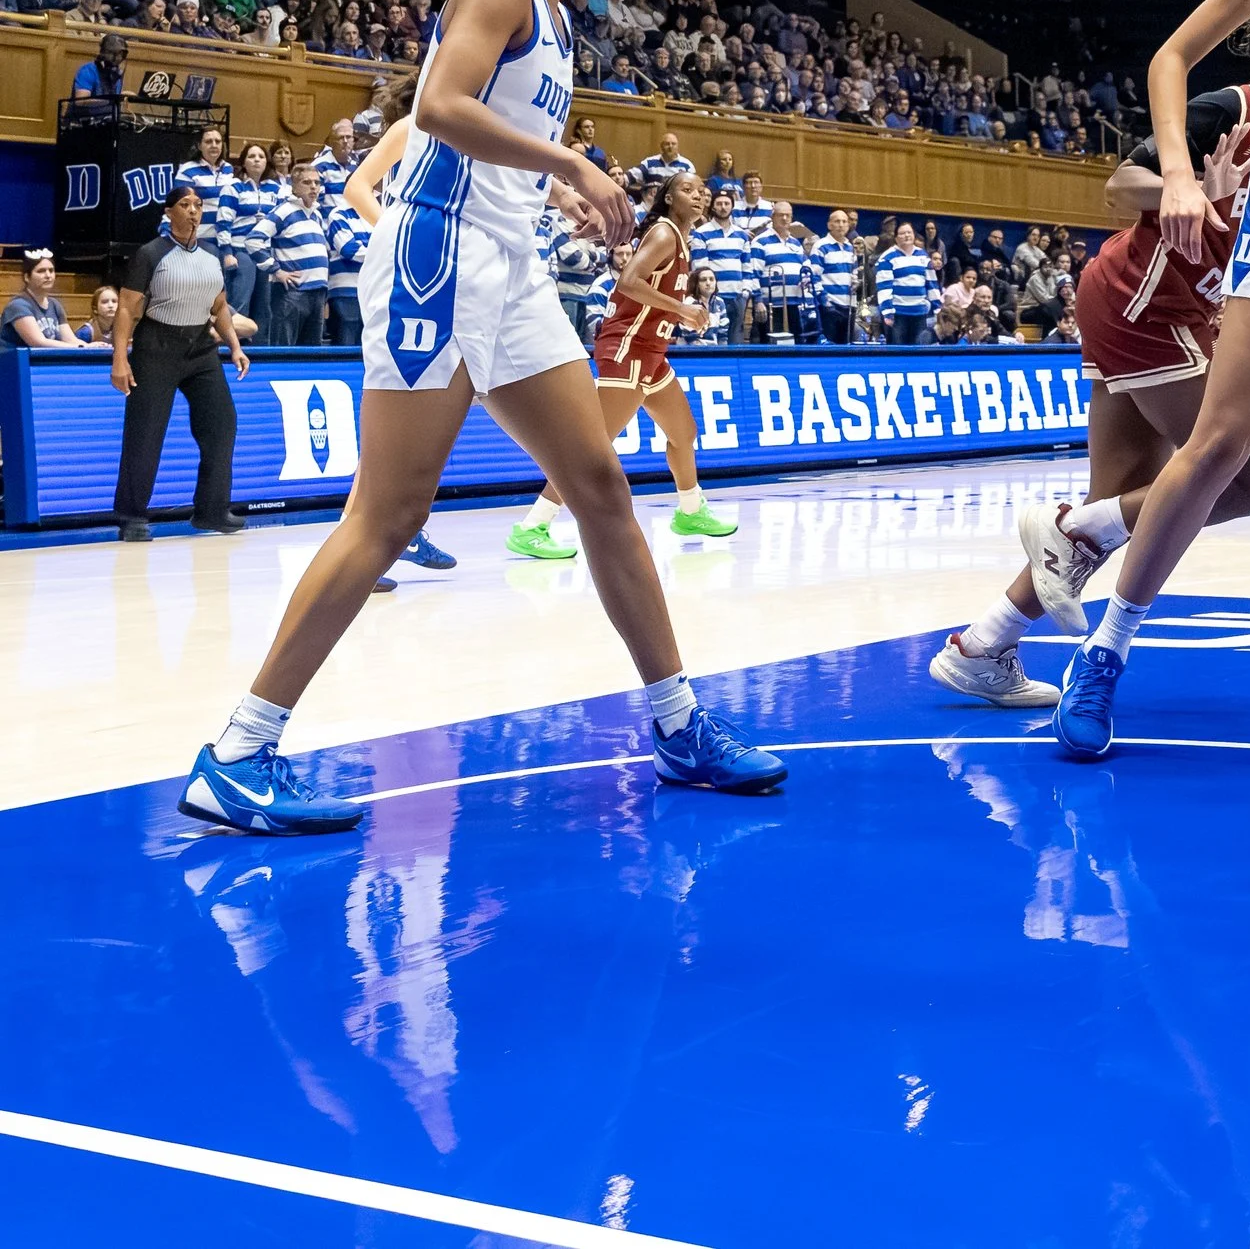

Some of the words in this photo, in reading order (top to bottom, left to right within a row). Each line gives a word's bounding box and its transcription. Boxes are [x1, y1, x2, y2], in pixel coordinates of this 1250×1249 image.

[531, 72, 573, 126] DUK
[122, 163, 174, 211] DU
[752, 368, 1091, 448] BASKETBALL
